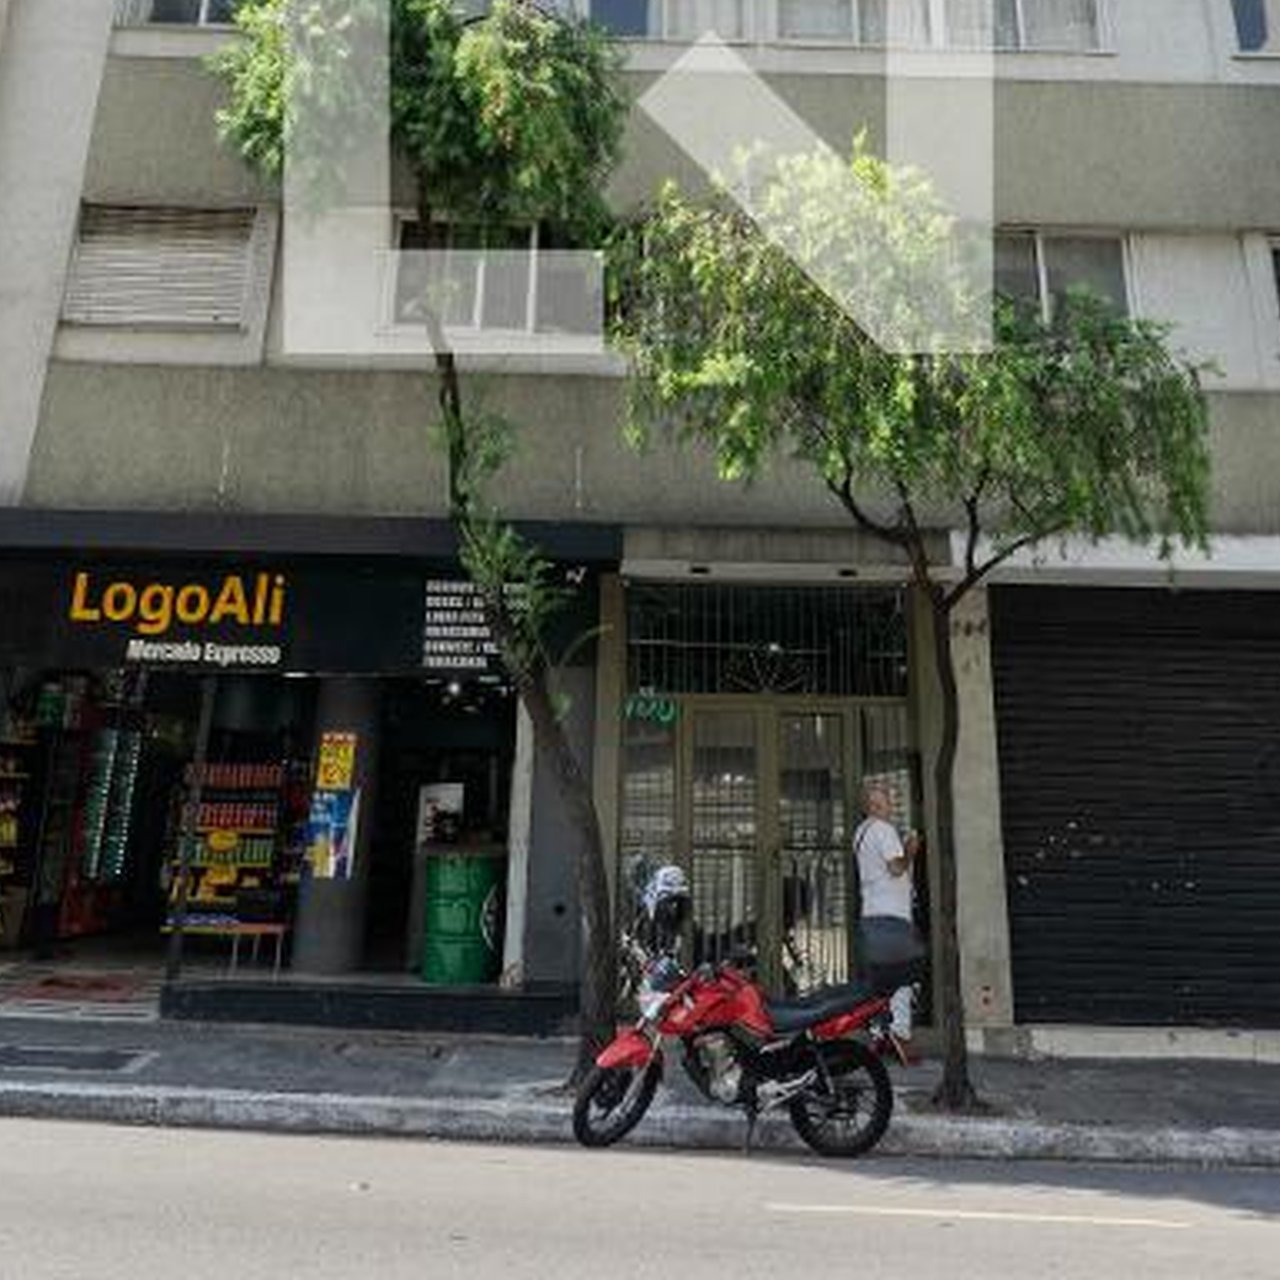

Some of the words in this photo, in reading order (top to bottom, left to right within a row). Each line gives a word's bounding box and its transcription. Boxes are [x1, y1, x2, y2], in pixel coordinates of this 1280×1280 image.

[71, 572, 285, 634] LogoAli
[127, 639, 201, 662] Mercado
[203, 643, 281, 667] Expresso
